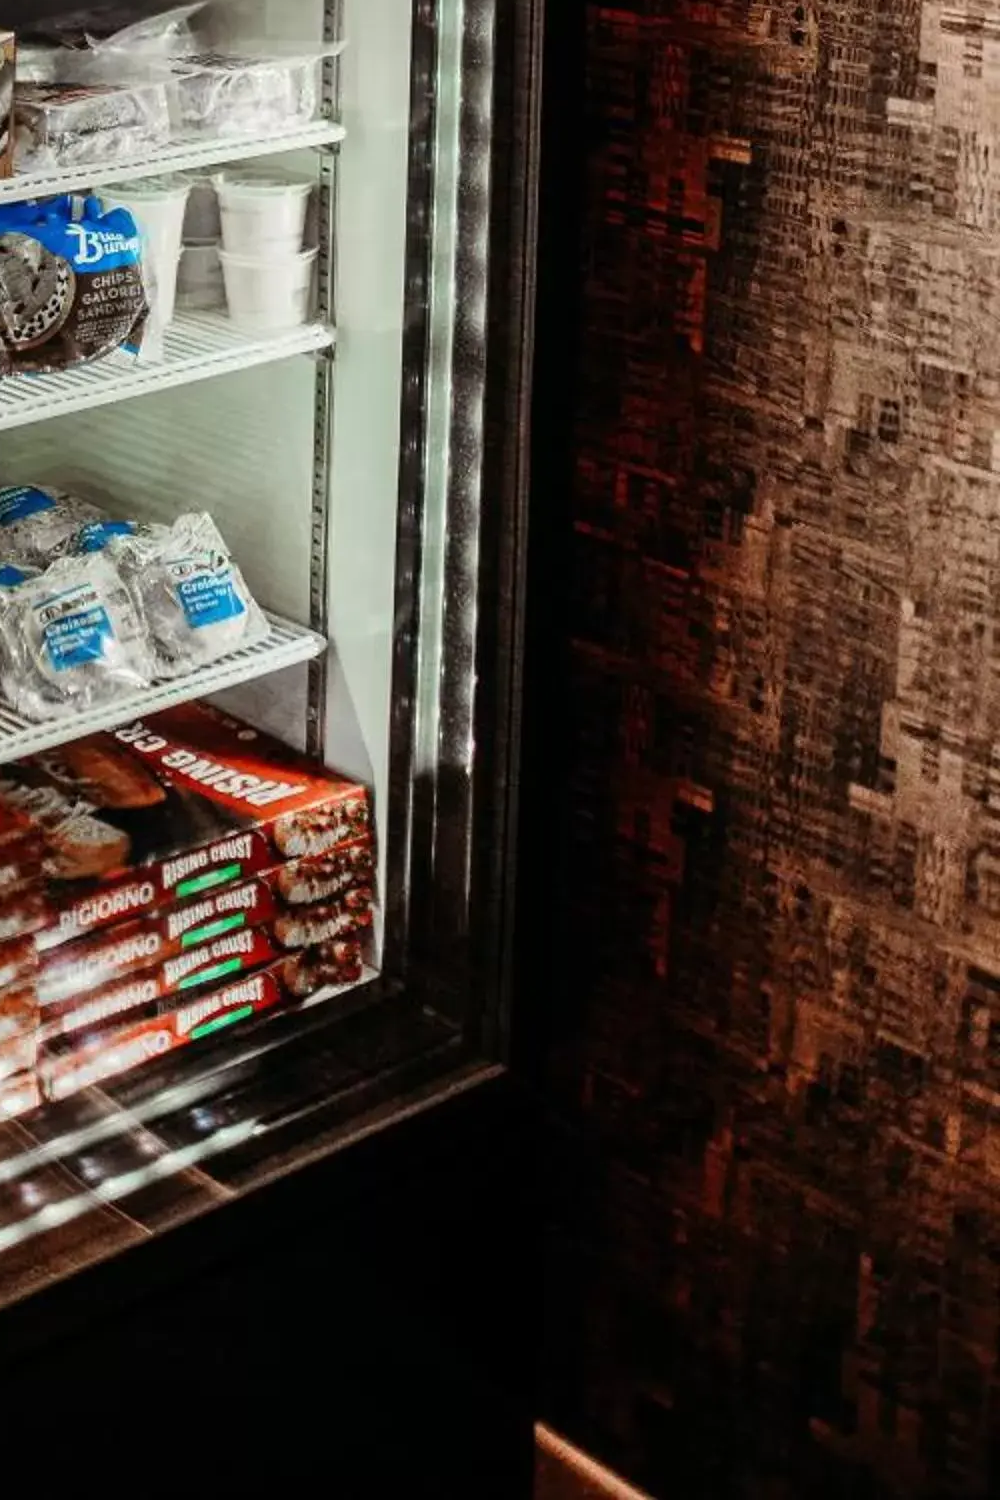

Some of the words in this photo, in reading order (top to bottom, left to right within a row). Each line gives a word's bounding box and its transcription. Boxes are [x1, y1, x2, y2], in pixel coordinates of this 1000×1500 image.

[91, 270, 134, 289] CHIPS
[77, 298, 144, 321] SANDWIC
[160, 749, 309, 807] RISING
[162, 850, 208, 889] RISING
[210, 833, 254, 862] CRUST
[167, 901, 214, 940] RISING
[215, 884, 258, 912] CRUST
[211, 929, 254, 958] CRUST
